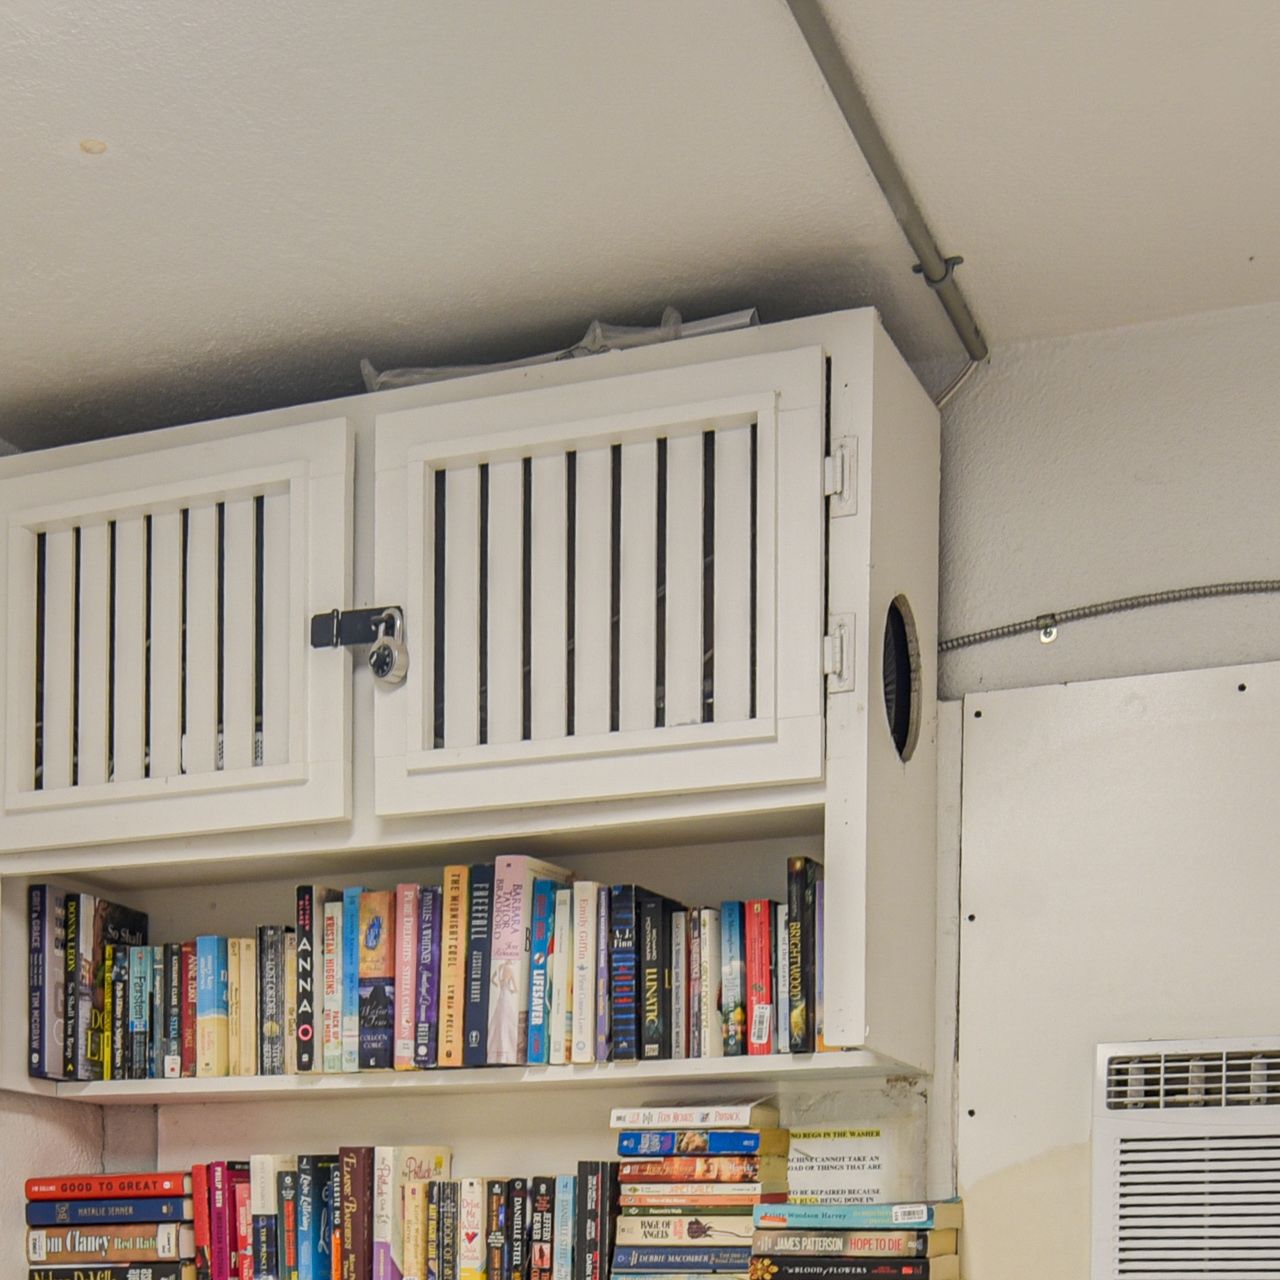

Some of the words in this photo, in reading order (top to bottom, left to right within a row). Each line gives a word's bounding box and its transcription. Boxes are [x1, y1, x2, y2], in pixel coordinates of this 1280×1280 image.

[450, 873, 460, 891] THE
[404, 890, 413, 915] PURE
[471, 883, 489, 941] FREEFALL
[493, 878, 505, 940] BRADFORD
[502, 889, 512, 930] TAYLOR
[510, 883, 523, 935] BARBARA
[577, 898, 588, 929] Emily
[67, 901, 77, 940] DONNA
[448, 895, 459, 942] MIDNIGHT
[31, 919, 40, 948] GRACE
[107, 924, 120, 940] So
[120, 927, 144, 946] Shall
[326, 916, 335, 954] KRISTAN
[403, 917, 413, 962] DELIGHTS
[577, 930, 588, 960] Giffin
[614, 938, 633, 948] Finn
[67, 943, 77, 972] LEON
[421, 930, 432, 964] WHITNEY
[447, 944, 458, 967] COOL
[788, 921, 801, 1000] BRIGHTWOOD
[67, 982, 75, 994] So
[326, 959, 335, 996] HIGGINS
[31, 991, 40, 1006] TIM
[67, 995, 75, 1017] Shall
[531, 969, 545, 1025] LIFESAVER
[645, 968, 658, 1026] LUNATIC
[31, 1008, 40, 1049] MCGRAW
[67, 1019, 75, 1035] You
[65, 1037, 74, 1059] Reap
[61, 1182, 92, 1192] GOOD
[98, 1182, 113, 1191] TO
[119, 1180, 160, 1191] GREAT
[214, 1166, 222, 1189] PHILIP
[300, 1174, 311, 1194] Love
[333, 1171, 341, 1208] CELESTE
[78, 1207, 106, 1216] NATALIE
[299, 1195, 312, 1231] Lettering
[513, 1197, 522, 1240] DANIELLE
[560, 1199, 569, 1235] DANIELLE
[640, 1220, 660, 1229] RAGE
[662, 1220, 670, 1229] OF
[822, 1212, 847, 1220] Harvey
[532, 1212, 541, 1241] DEAVER
[543, 1211, 552, 1241] JEFFERY
[642, 1230, 669, 1239] ANGELS
[66, 1230, 110, 1257] Clancy
[114, 1237, 133, 1249] Red
[513, 1241, 522, 1265] STEEL
[560, 1236, 569, 1260] STEEL
[774, 1237, 801, 1250] JAMES
[802, 1237, 843, 1250] PATTERSON
[849, 1238, 873, 1249] HOPE
[875, 1238, 886, 1249] TO
[888, 1238, 902, 1249] DIE
[585, 1253, 593, 1276] DARK
[639, 1254, 664, 1262] DEBBIE
[668, 1254, 709, 1263] MACOMBER
[794, 1266, 823, 1274] BLOOD
[829, 1266, 867, 1274] FLOWERS
